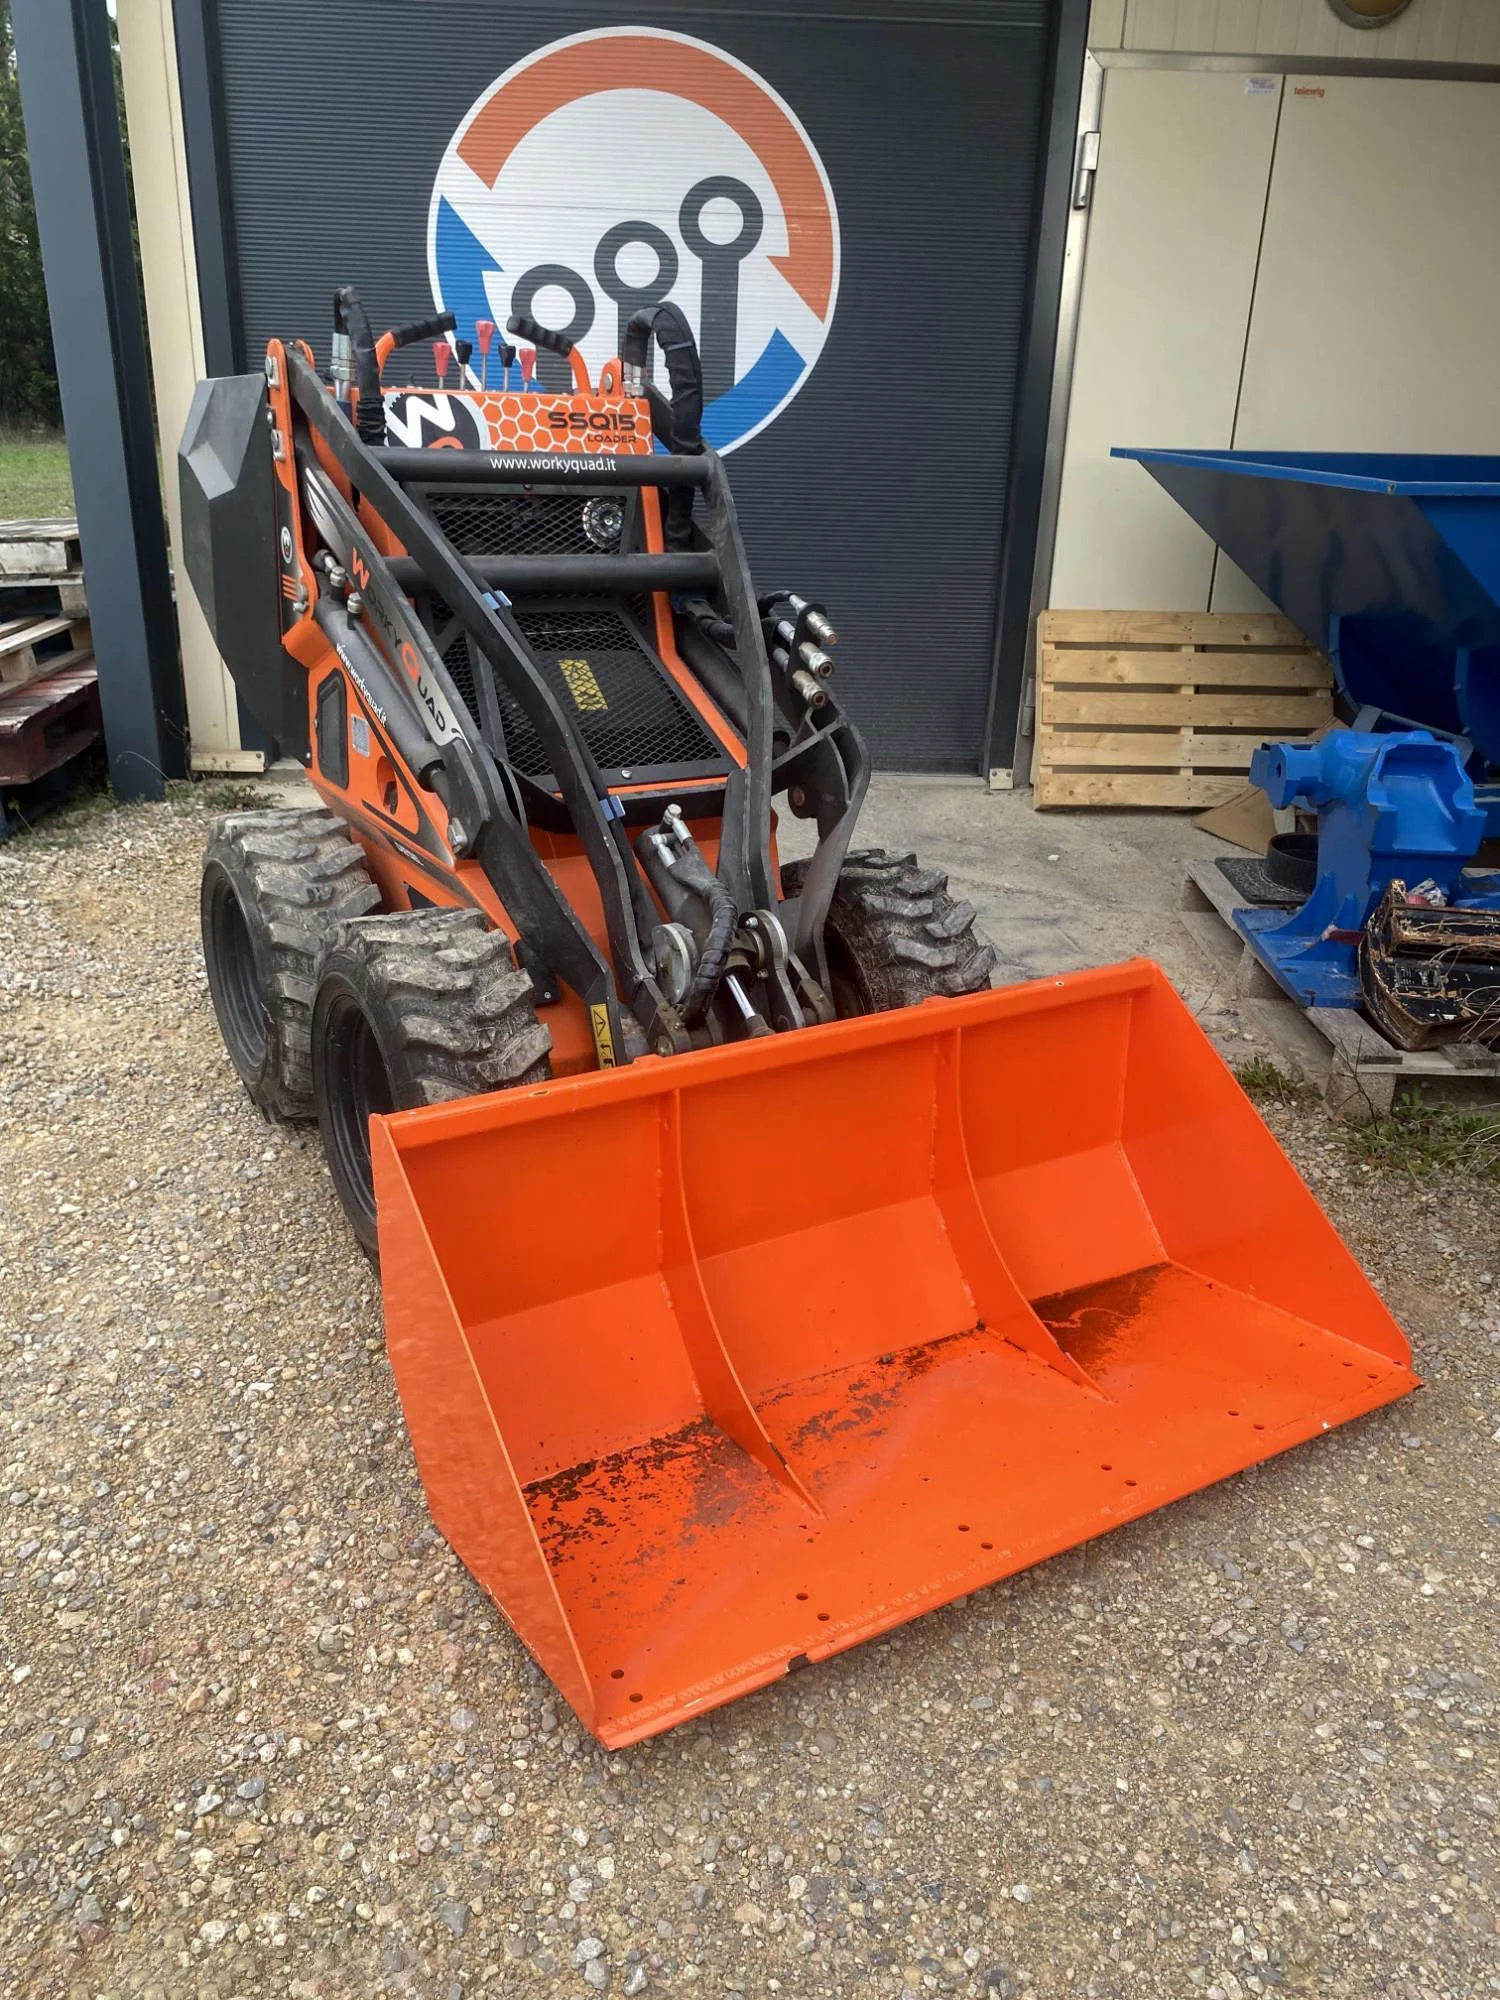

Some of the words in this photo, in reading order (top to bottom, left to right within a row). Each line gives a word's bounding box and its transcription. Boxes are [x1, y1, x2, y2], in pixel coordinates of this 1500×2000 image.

[549, 411, 636, 430] SSQ15
[587, 434, 636, 443] LOADER
[490, 457, 616, 473] www.workyquad.it
